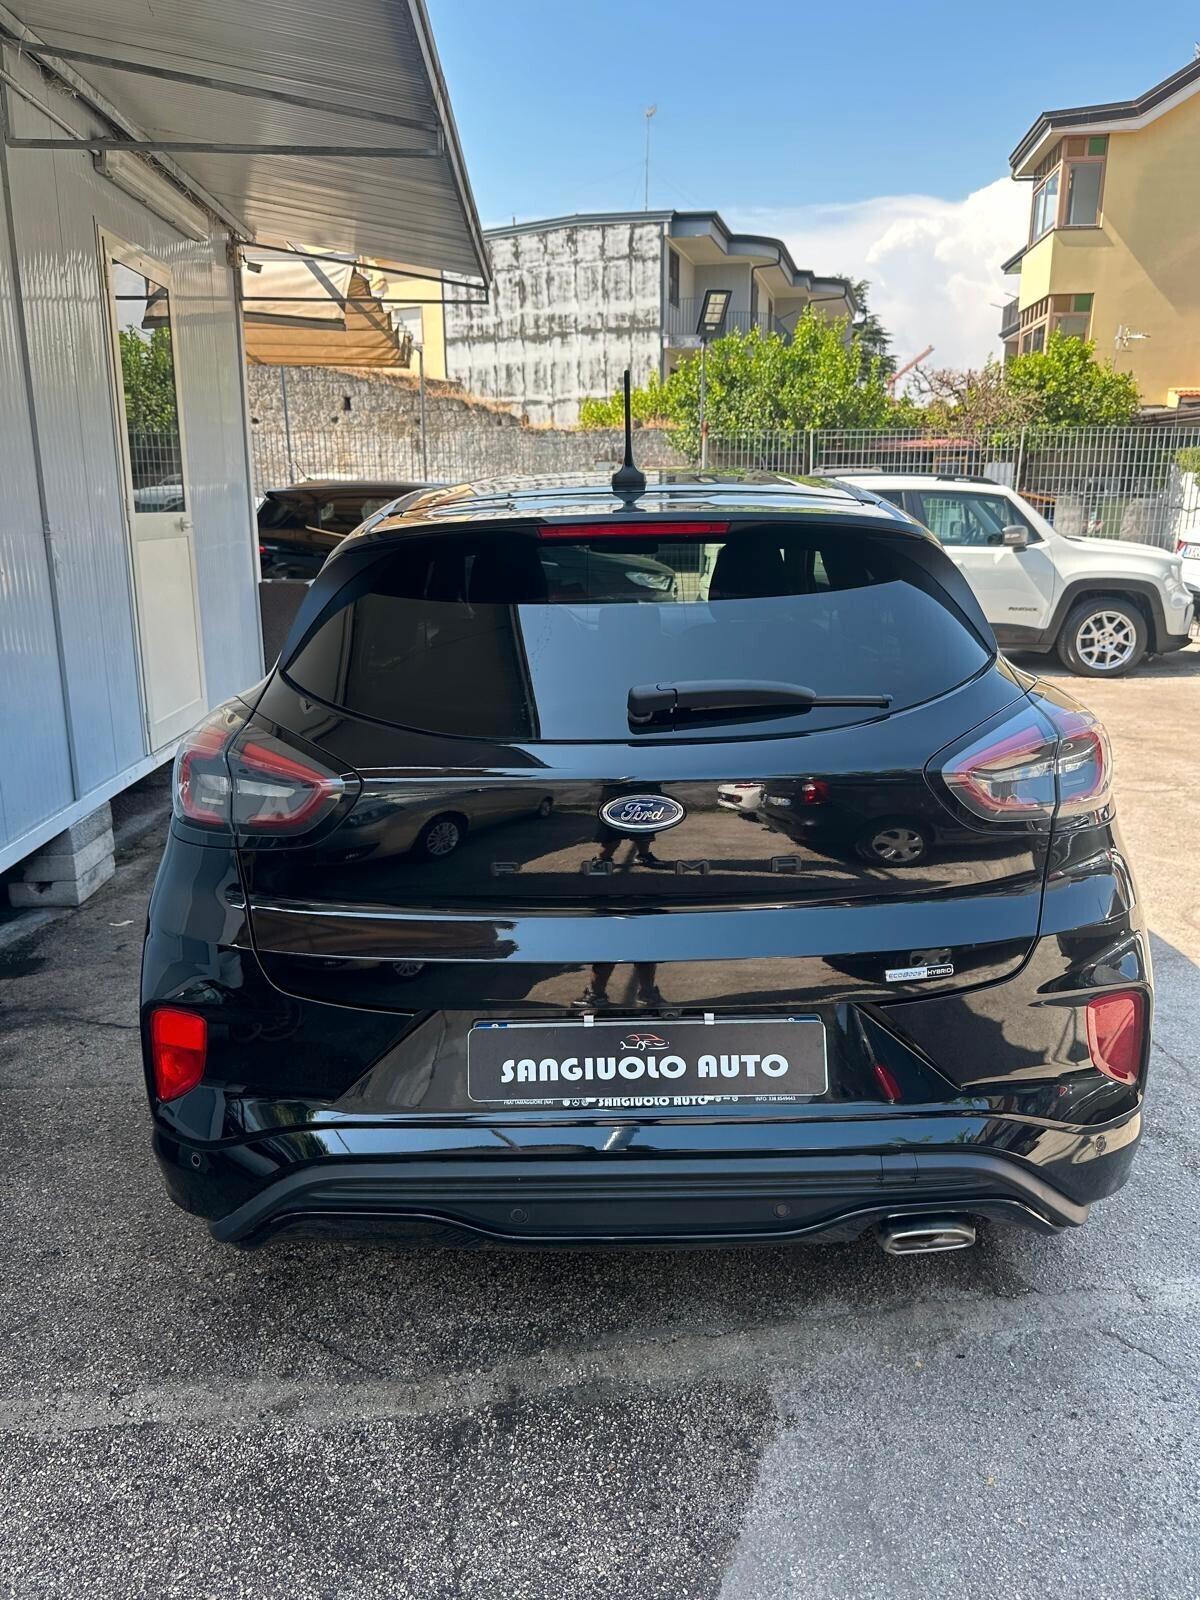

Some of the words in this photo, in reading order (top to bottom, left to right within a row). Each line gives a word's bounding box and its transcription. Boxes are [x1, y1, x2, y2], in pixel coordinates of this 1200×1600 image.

[620, 802, 665, 821] Ford
[491, 856, 800, 876] PUMA
[927, 967, 952, 976] HYBRID
[501, 1055, 687, 1084] SANGIUOLO
[698, 1054, 789, 1079] AUTO
[597, 1096, 670, 1107] SANGIUOLO
[673, 1095, 709, 1106] AUTO
